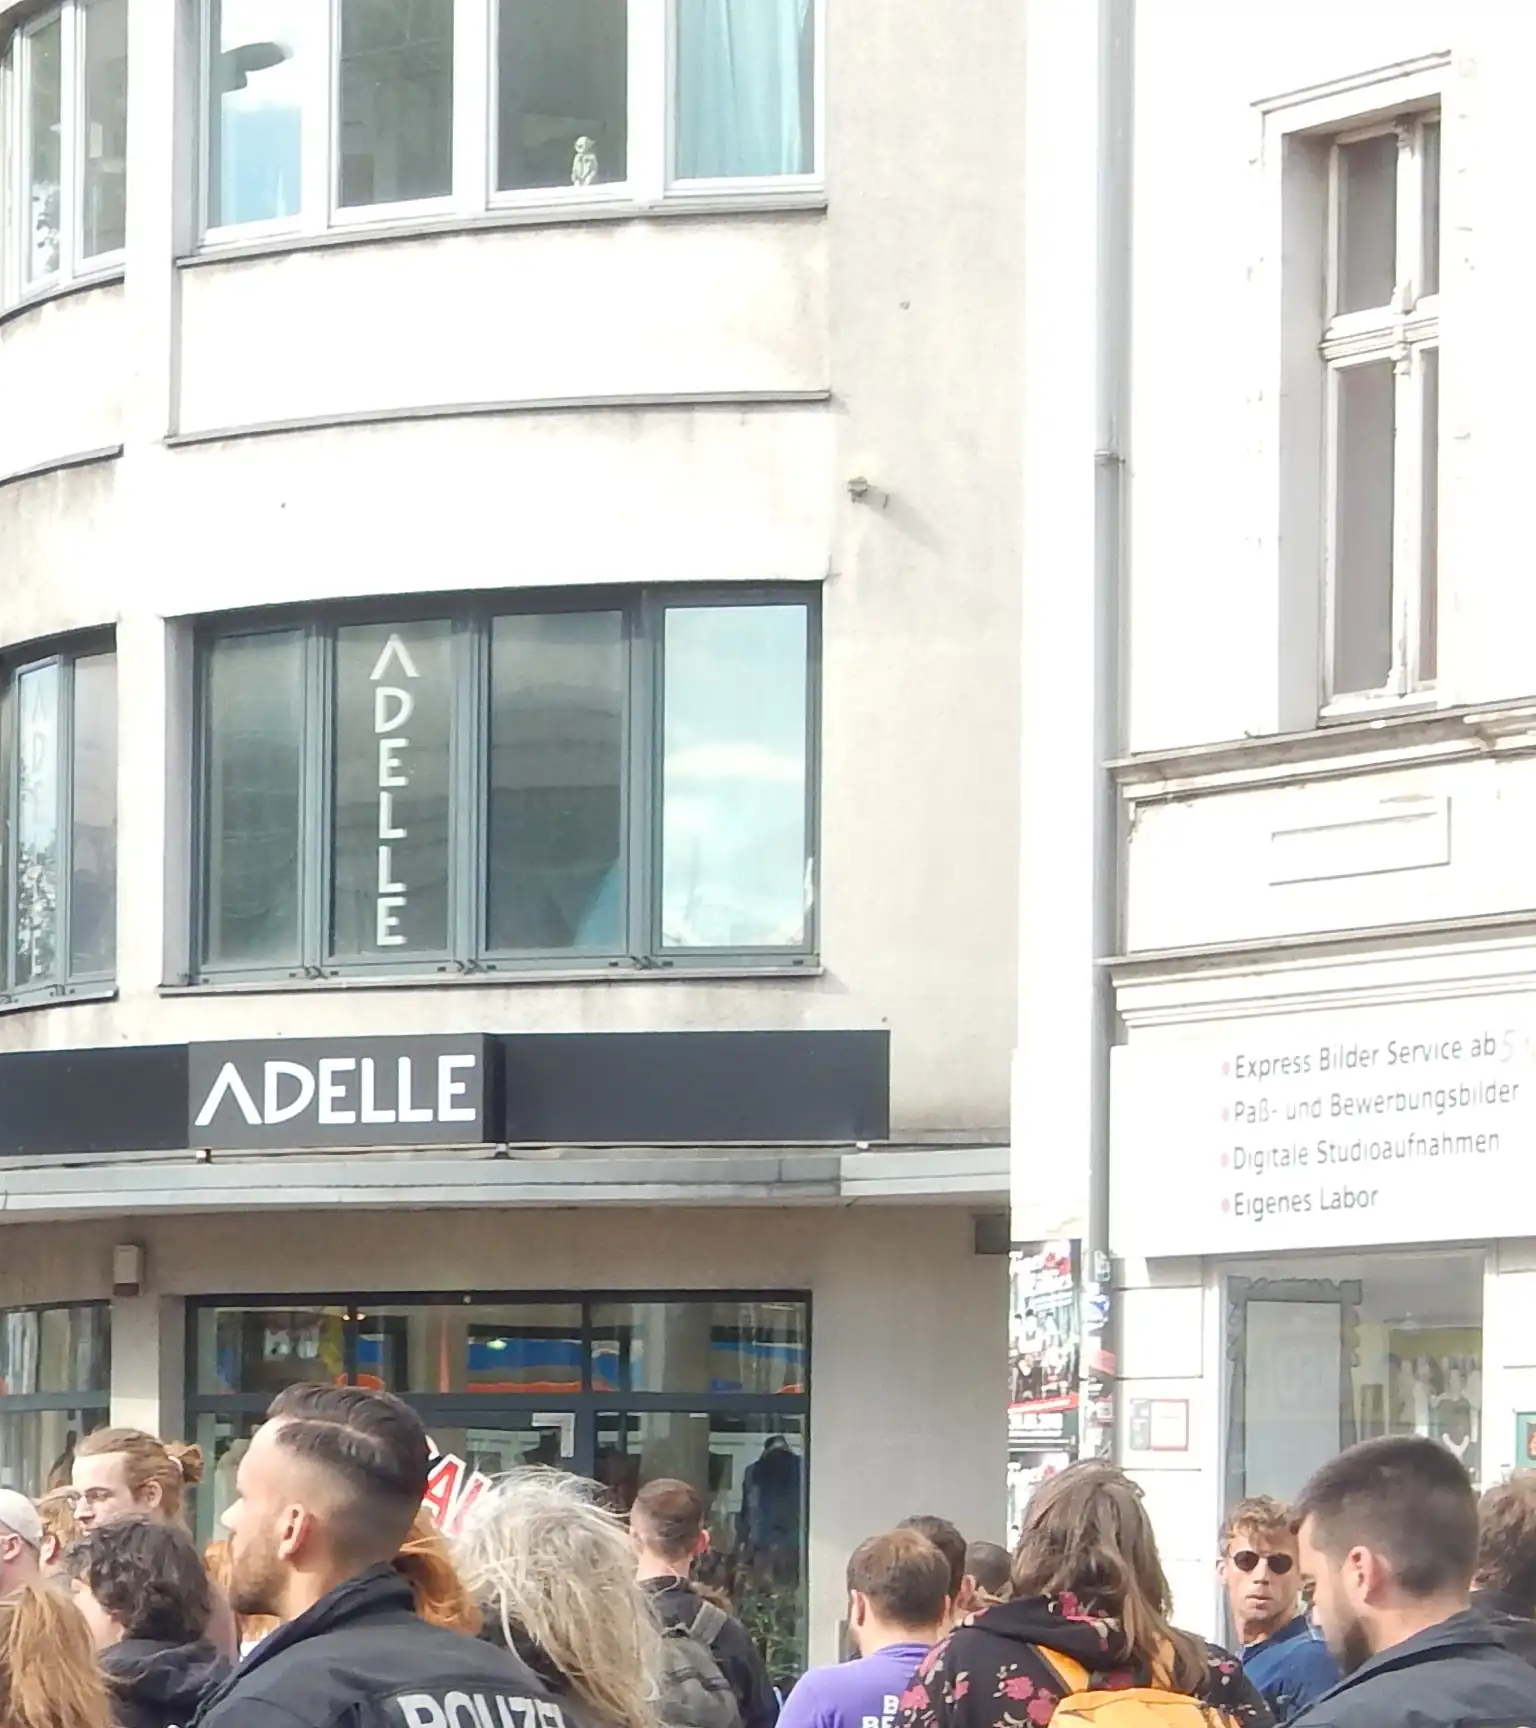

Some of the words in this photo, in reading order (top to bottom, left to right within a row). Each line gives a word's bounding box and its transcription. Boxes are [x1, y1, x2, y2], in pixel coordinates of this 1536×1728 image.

[370, 633, 421, 947] ADELLE
[1235, 1054, 1312, 1082] Express
[1319, 1043, 1379, 1071] Bilder
[1387, 1039, 1463, 1065] Service
[1471, 1031, 1496, 1057] ab
[194, 1054, 476, 1126] ADELLE
[1234, 1097, 1277, 1124] Paß-
[1285, 1095, 1322, 1120] und
[1330, 1080, 1520, 1117] Bewerbungsbilder
[1233, 1142, 1308, 1175] Digitale
[1317, 1132, 1500, 1164] Studioaufnahmen
[1234, 1192, 1312, 1222] Eigenes
[1320, 1184, 1379, 1211] Labor
